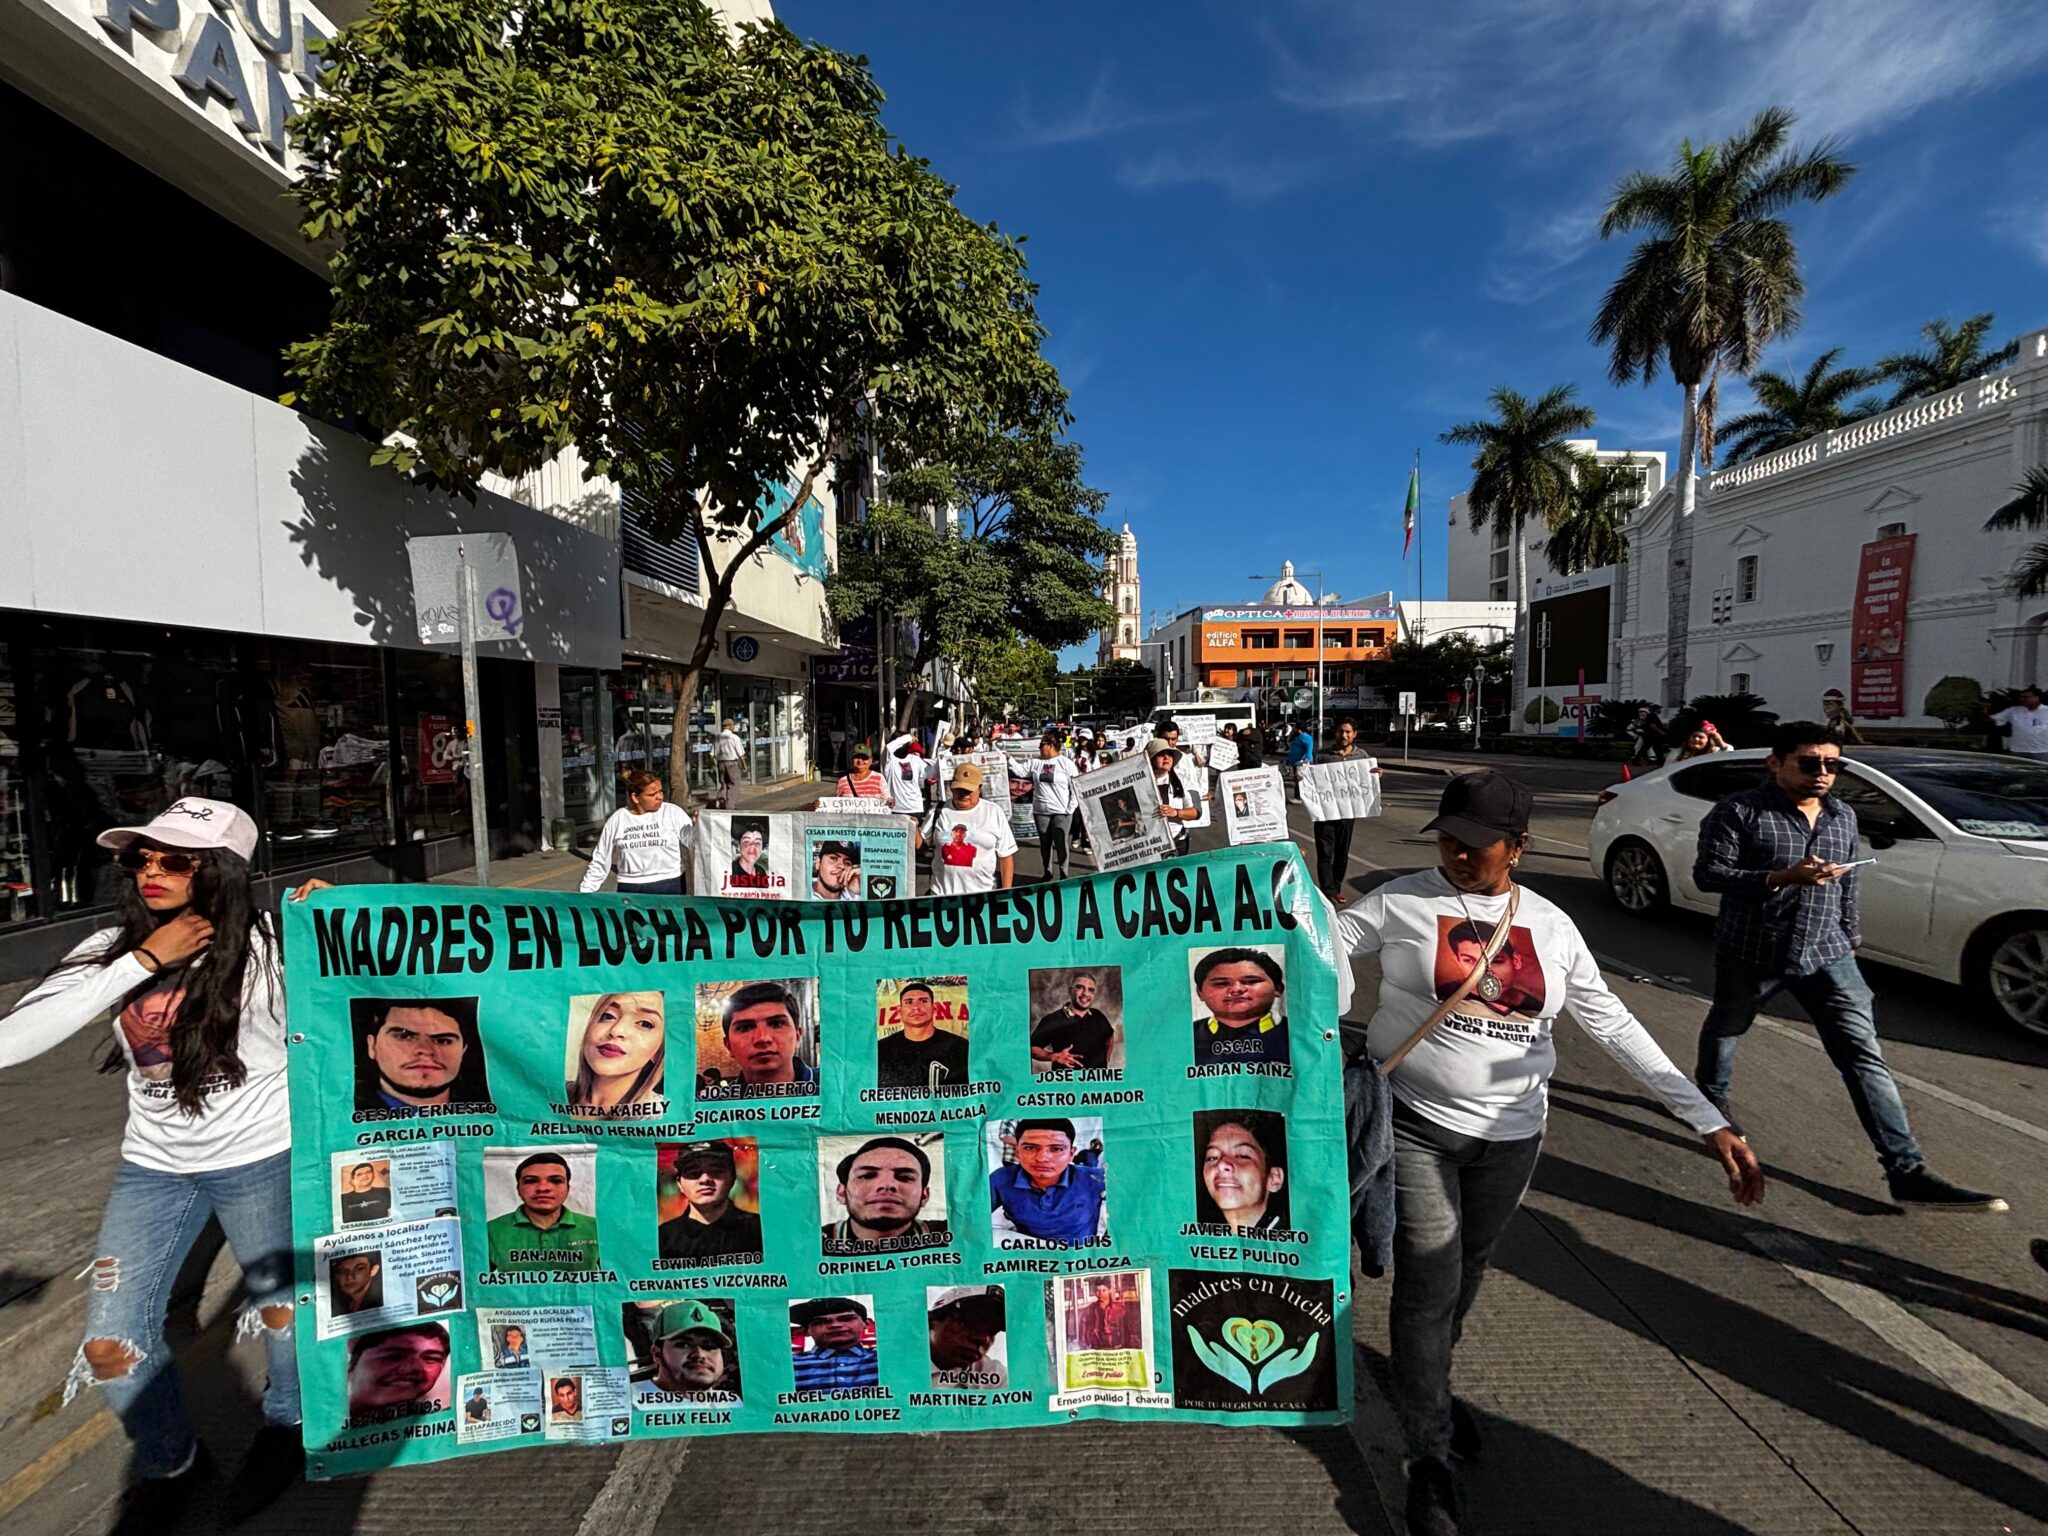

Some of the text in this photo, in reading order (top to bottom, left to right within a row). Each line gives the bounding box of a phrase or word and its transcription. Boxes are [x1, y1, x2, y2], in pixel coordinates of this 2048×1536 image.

[1224, 610, 1284, 619] OPTICA
[1206, 632, 1238, 640] edificio
[1208, 639, 1236, 648] ALFA
[1325, 765, 1357, 784] UNA
[1082, 786, 1108, 799] MARCHA
[1108, 779, 1121, 791] POR
[1341, 783, 1371, 798] MAS
[805, 828, 826, 837] CESAR
[827, 829, 857, 837] ERNESTO
[881, 830, 907, 839] PULIDO
[720, 871, 786, 891] justicia
[313, 904, 495, 978] MADRES
[503, 904, 563, 972] EN
[571, 904, 714, 967] LUCHA
[717, 903, 807, 959] POR
[810, 901, 870, 953] TU
[873, 883, 1063, 951] REGRESO
[1076, 880, 1104, 941] A
[1113, 864, 1223, 940] CASA
[1443, 1017, 1537, 1044] VEGA ZAZUETA
[1486, 1019, 1530, 1033] RUBEN
[1211, 1039, 1265, 1056] OSCAR
[1036, 1068, 1124, 1084] JOSE JAIME
[1186, 1064, 1243, 1079] DARIAN
[701, 1080, 817, 1100] JOSE ALBERTO
[859, 1080, 1001, 1103] CRECENCIO HUMBERTO
[1016, 1089, 1145, 1107] CASTRO AMADOR
[351, 1100, 498, 1124] CESAR ERNESTO
[548, 1100, 671, 1118] YARITZA KARELY
[693, 1104, 821, 1125] SICAIROS LOPEZ
[875, 1103, 988, 1126] MENDOZA ALCALA
[356, 1123, 495, 1146] GARCIA PULIDO
[530, 1121, 696, 1139] ARELLANO HERNANDEZ
[340, 1217, 393, 1230] DESAPARECIDO
[323, 1231, 376, 1248] Ayúdanos
[386, 1222, 431, 1237] localizar
[347, 1241, 383, 1254] manuel
[384, 1235, 423, 1249] Sánchez
[424, 1231, 448, 1242] leyva
[822, 1231, 954, 1252] CESAR EDUARDO
[999, 1233, 1113, 1252] CARLOS LUIS
[1178, 1222, 1310, 1245] JAVIER ERNESTO
[391, 1240, 440, 1255] Desaparecido
[420, 1248, 447, 1258] Sinaloa
[1188, 1244, 1301, 1267] VELEZ PULIDO
[413, 1261, 434, 1269] enero
[509, 1250, 584, 1264] BANJAMIN
[651, 1251, 764, 1272] EDWIN ALFREDO
[817, 1251, 962, 1276] ORPINELA TORRES
[982, 1255, 1133, 1275] RAMIREZ TOLOZA
[398, 1270, 416, 1278] edad
[425, 1265, 444, 1273] años
[478, 1271, 549, 1286] CASTILLO
[551, 1269, 618, 1285] ZAZUETA
[629, 1273, 789, 1292] CERVANTES VIZCVARRA
[1172, 1276, 1332, 1327] madres en lucha
[508, 1317, 539, 1325] ANTONIO
[937, 1370, 1000, 1386] ALONSO
[636, 1389, 738, 1405] JESUS TOMAS
[777, 1386, 894, 1406] ENGEL GABRIEL
[908, 1390, 1033, 1408] MARTINEZ AYON
[1056, 1392, 1170, 1406] Ernesto pulido chavira
[1184, 1399, 1205, 1409] POR
[1221, 1400, 1268, 1410] REGRESO
[464, 1418, 516, 1432] DESAPARECIDO
[645, 1410, 732, 1427] FELIX FELIX
[773, 1407, 902, 1425] ALVARADO LOPEZ
[402, 1419, 457, 1441] MEDINA
